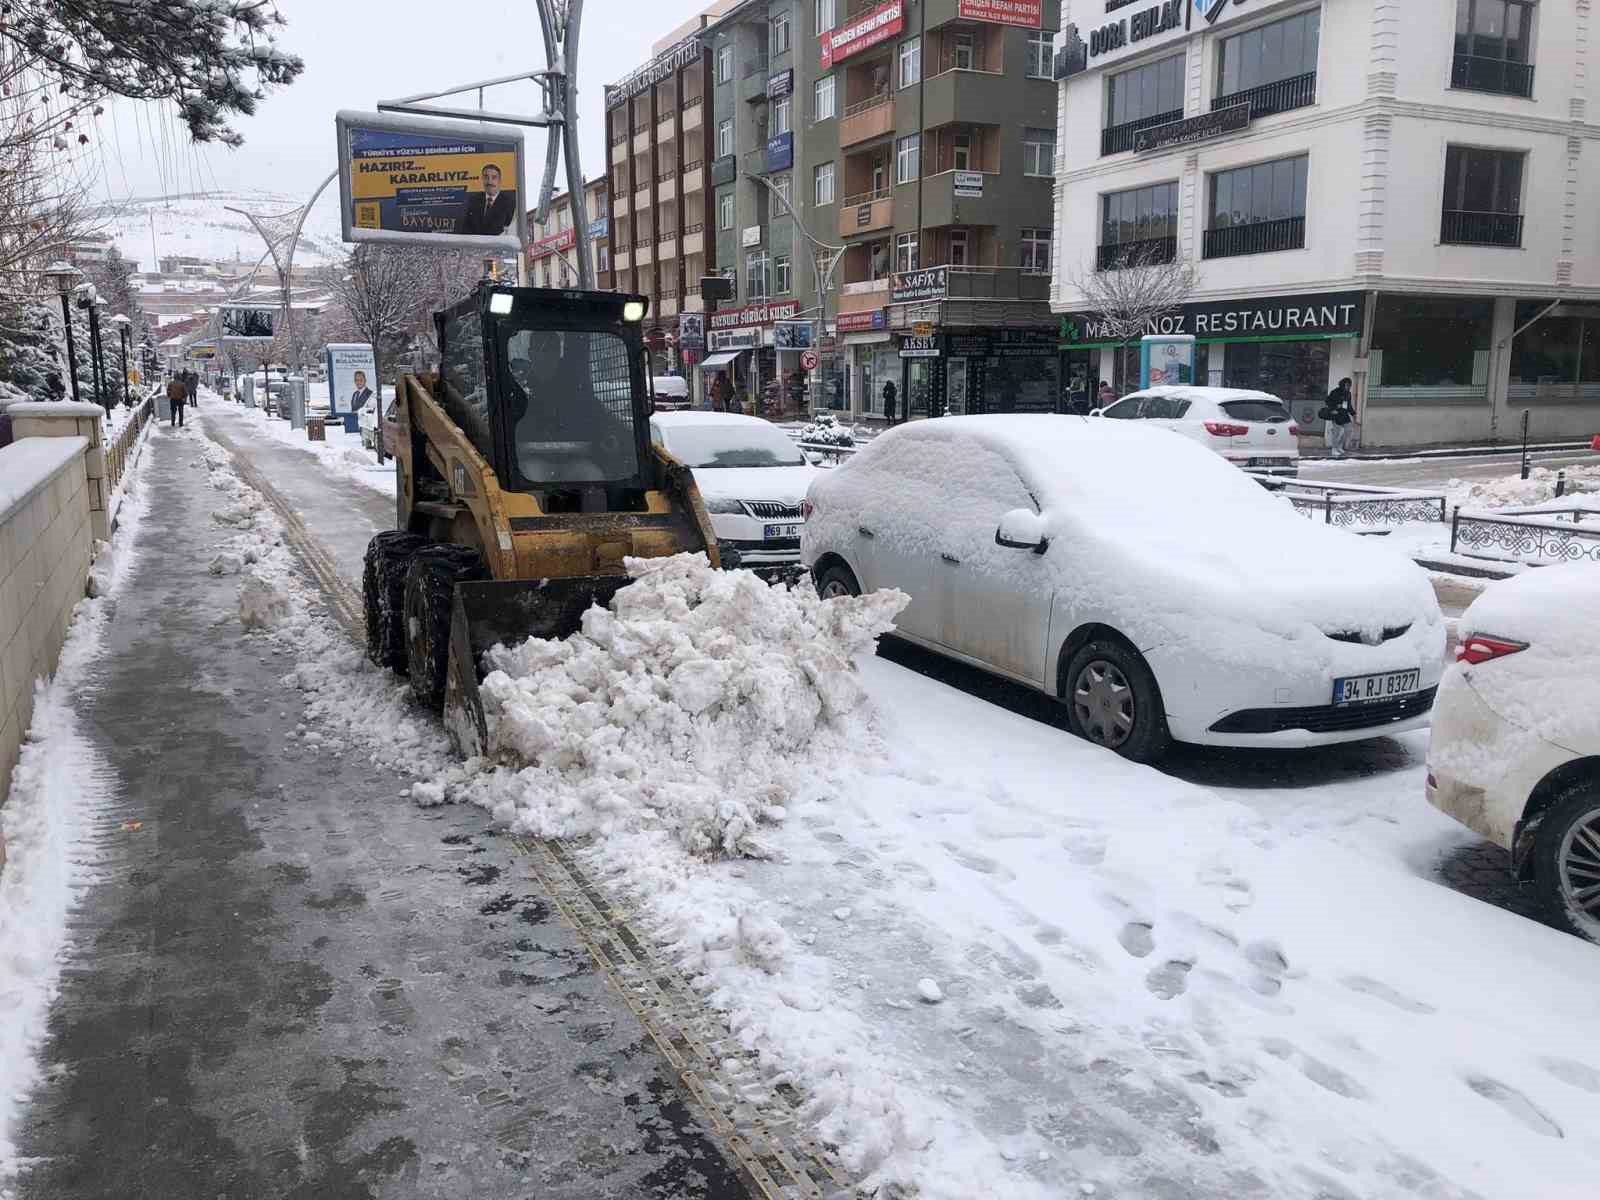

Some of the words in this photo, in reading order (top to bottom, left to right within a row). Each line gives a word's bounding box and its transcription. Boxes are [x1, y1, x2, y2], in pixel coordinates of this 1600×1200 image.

[1090, 19, 1127, 57] DORA
[360, 160, 425, 173] HAZIRIZ...
[390, 170, 479, 184] KARARLIYIZ...
[740, 306, 768, 325] SÜRÜCÜ
[769, 304, 795, 321] KURSU
[1195, 304, 1356, 333] RESTAURANT
[1344, 680, 1360, 699] 34
[1366, 677, 1383, 697] RJ
[1386, 673, 1416, 694] 8327
